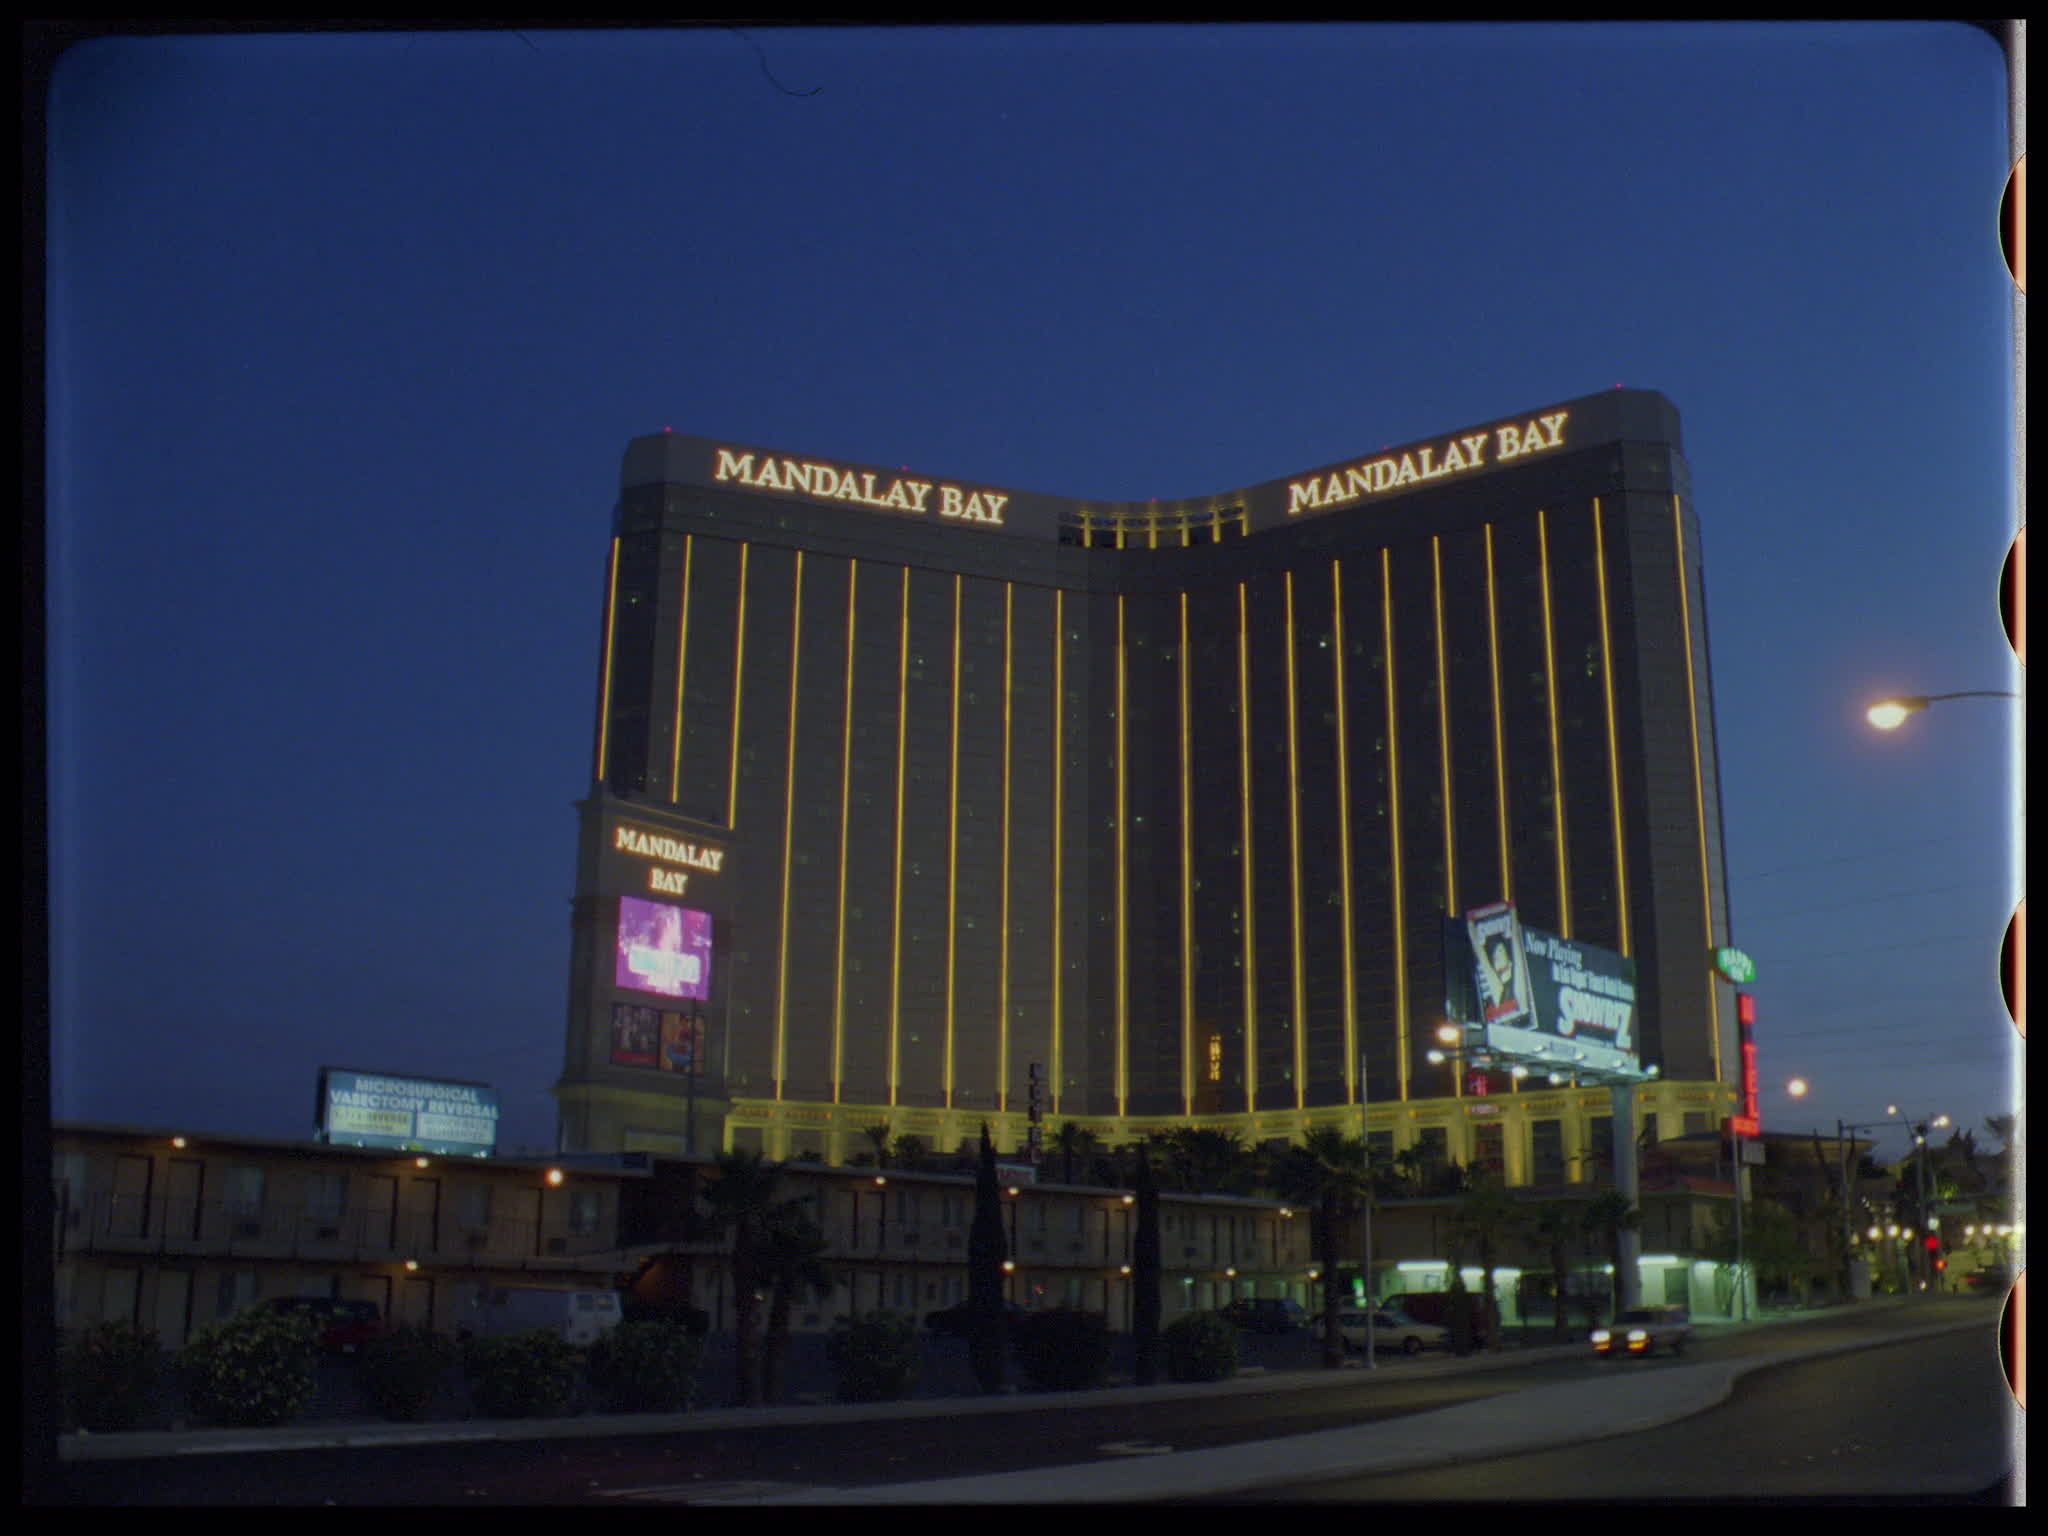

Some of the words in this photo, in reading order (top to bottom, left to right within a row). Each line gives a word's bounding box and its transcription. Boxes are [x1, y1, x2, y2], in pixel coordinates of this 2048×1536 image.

[1288, 434, 1488, 514] MANDALAY
[1496, 413, 1568, 461] BAY
[715, 448, 932, 512] MANDALAY
[940, 486, 1008, 524] BAY
[616, 827, 723, 871] MANDALAY
[651, 868, 688, 894] BAY
[1525, 931, 1546, 956] Now
[1547, 938, 1582, 969] Playing
[330, 1090, 426, 1110] VASECTOMY
[429, 1100, 499, 1120] REVERSAL
[355, 1079, 479, 1103] MICROSURGICAL
